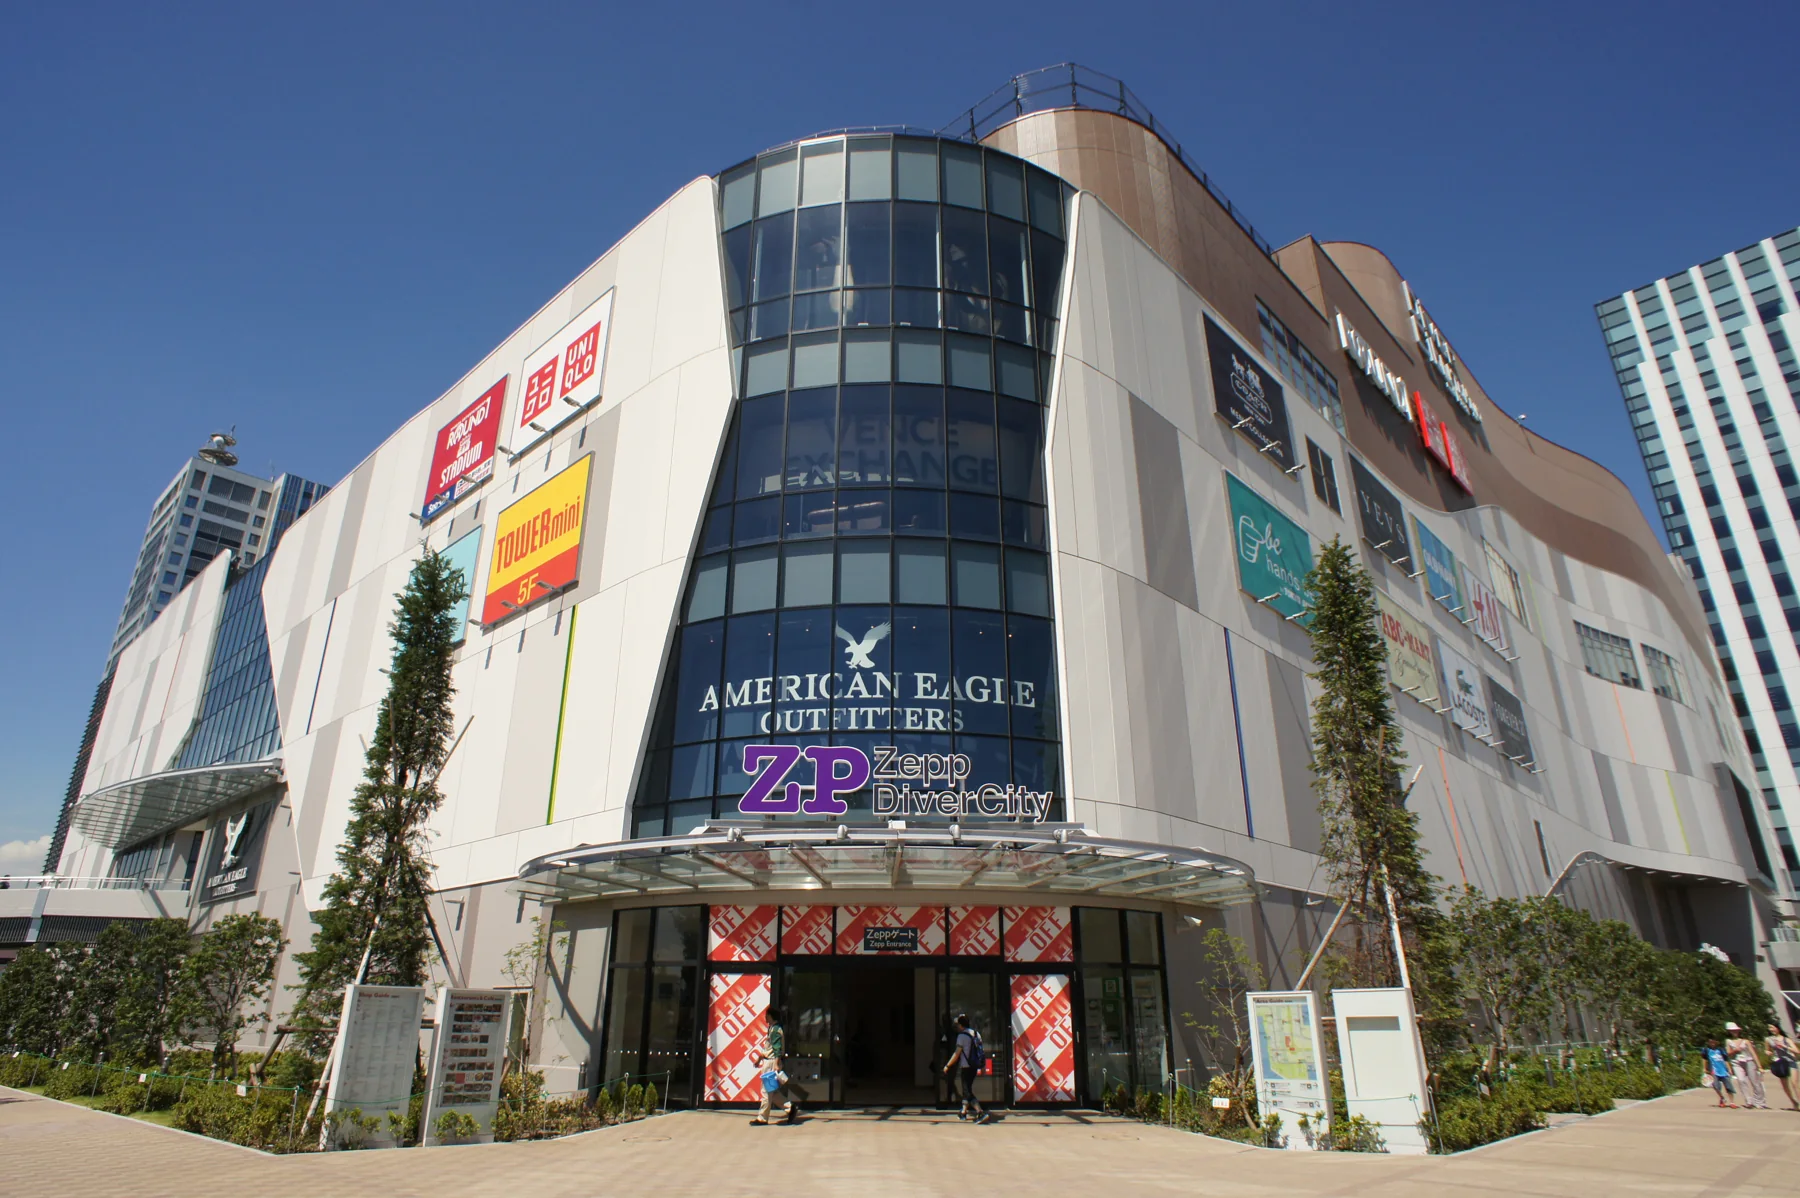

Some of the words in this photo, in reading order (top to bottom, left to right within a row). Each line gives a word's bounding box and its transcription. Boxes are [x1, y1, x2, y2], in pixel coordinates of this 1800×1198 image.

[568, 332, 594, 366] UNI
[528, 364, 553, 397] ユニ
[565, 354, 593, 389] QLO
[524, 385, 550, 420] クロ
[825, 416, 960, 446] VENCE
[439, 441, 483, 488] STADIUM
[786, 450, 998, 487] EXCHANGE
[1361, 489, 1406, 544] YEVS
[517, 573, 539, 605] 5F
[1266, 554, 1300, 591] hands
[699, 671, 903, 712] AMERICAN
[914, 672, 1037, 708] EAGLE
[1452, 691, 1488, 728] LACOSTE
[760, 707, 964, 733] OUTFITTERS
[738, 744, 871, 817] ZP
[872, 746, 972, 788] Zepp
[872, 782, 1053, 823] DiverCity
[866, 928, 915, 940] Zeppゲート
[869, 940, 885, 948] Zepp
[886, 940, 912, 948] Entrance
[1029, 911, 1062, 951] OFF
[722, 997, 757, 1038] OFF
[1021, 979, 1055, 1020] OFF
[1015, 1050, 1046, 1092] OFF
